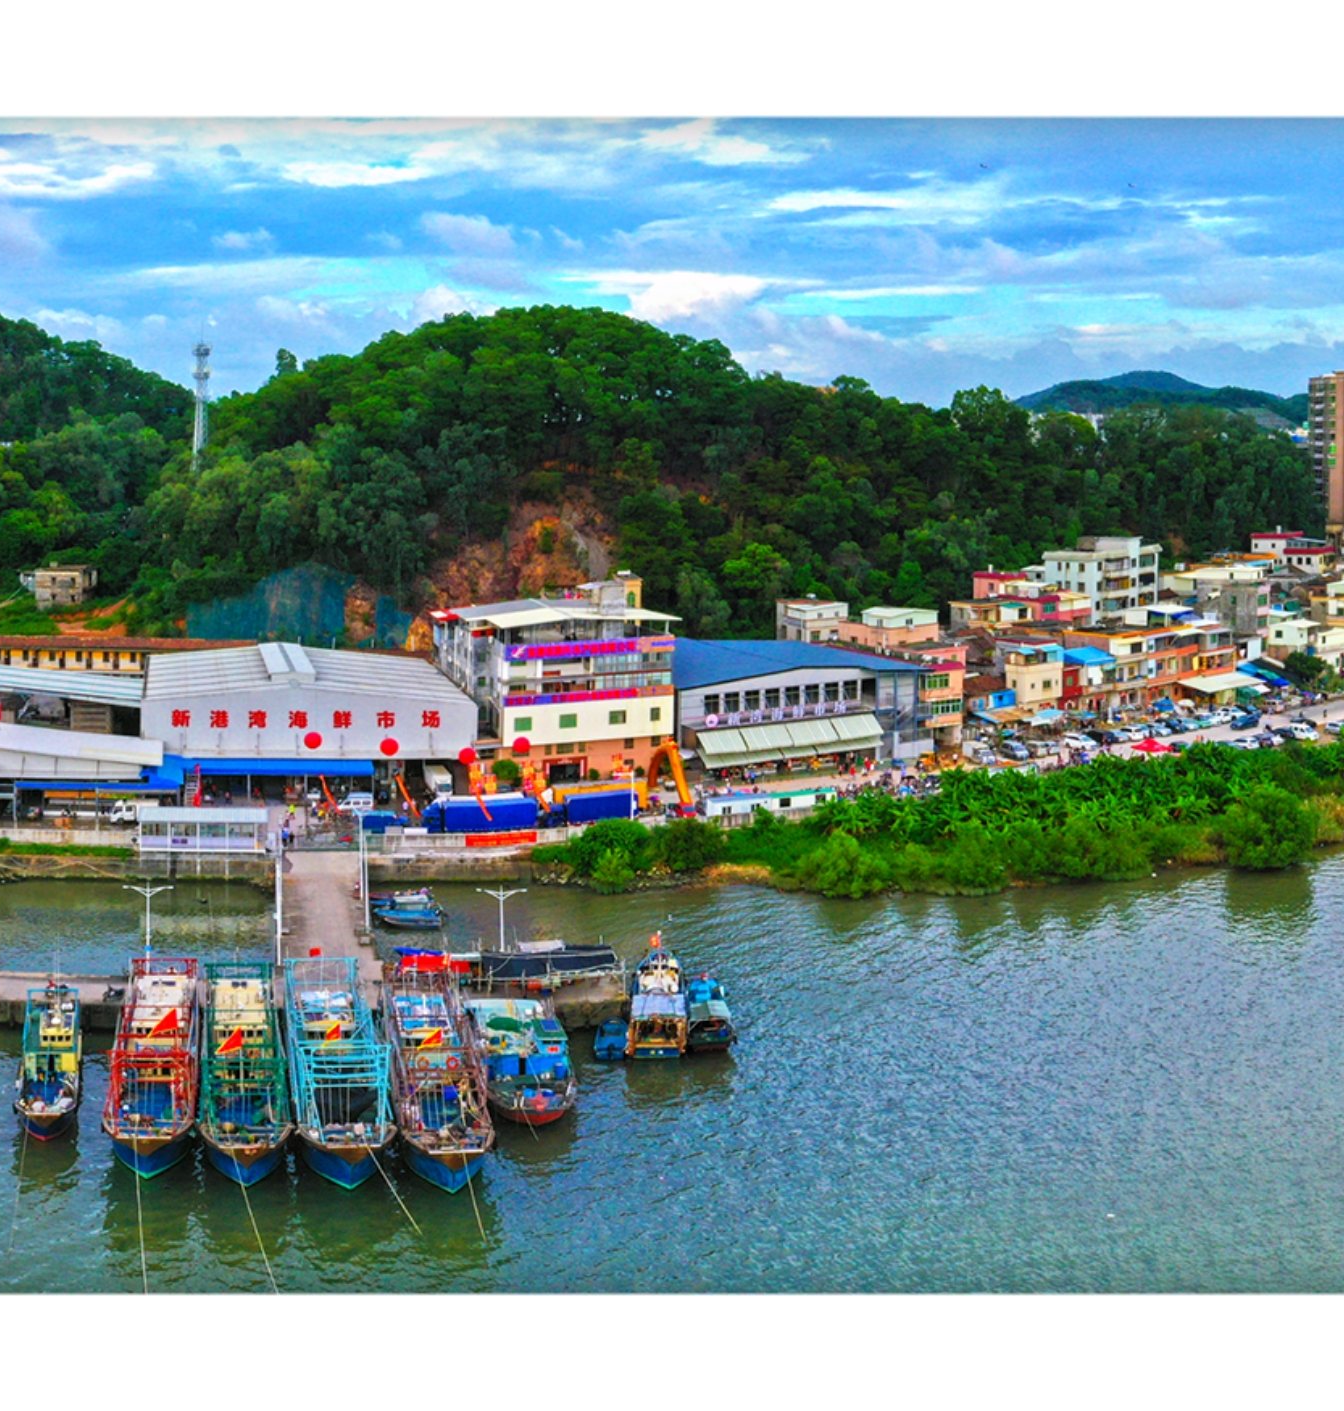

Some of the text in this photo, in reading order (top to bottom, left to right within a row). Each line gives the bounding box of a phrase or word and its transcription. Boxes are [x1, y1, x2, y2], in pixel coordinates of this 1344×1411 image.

[171, 709, 441, 729] 新港湾海鲜市场
